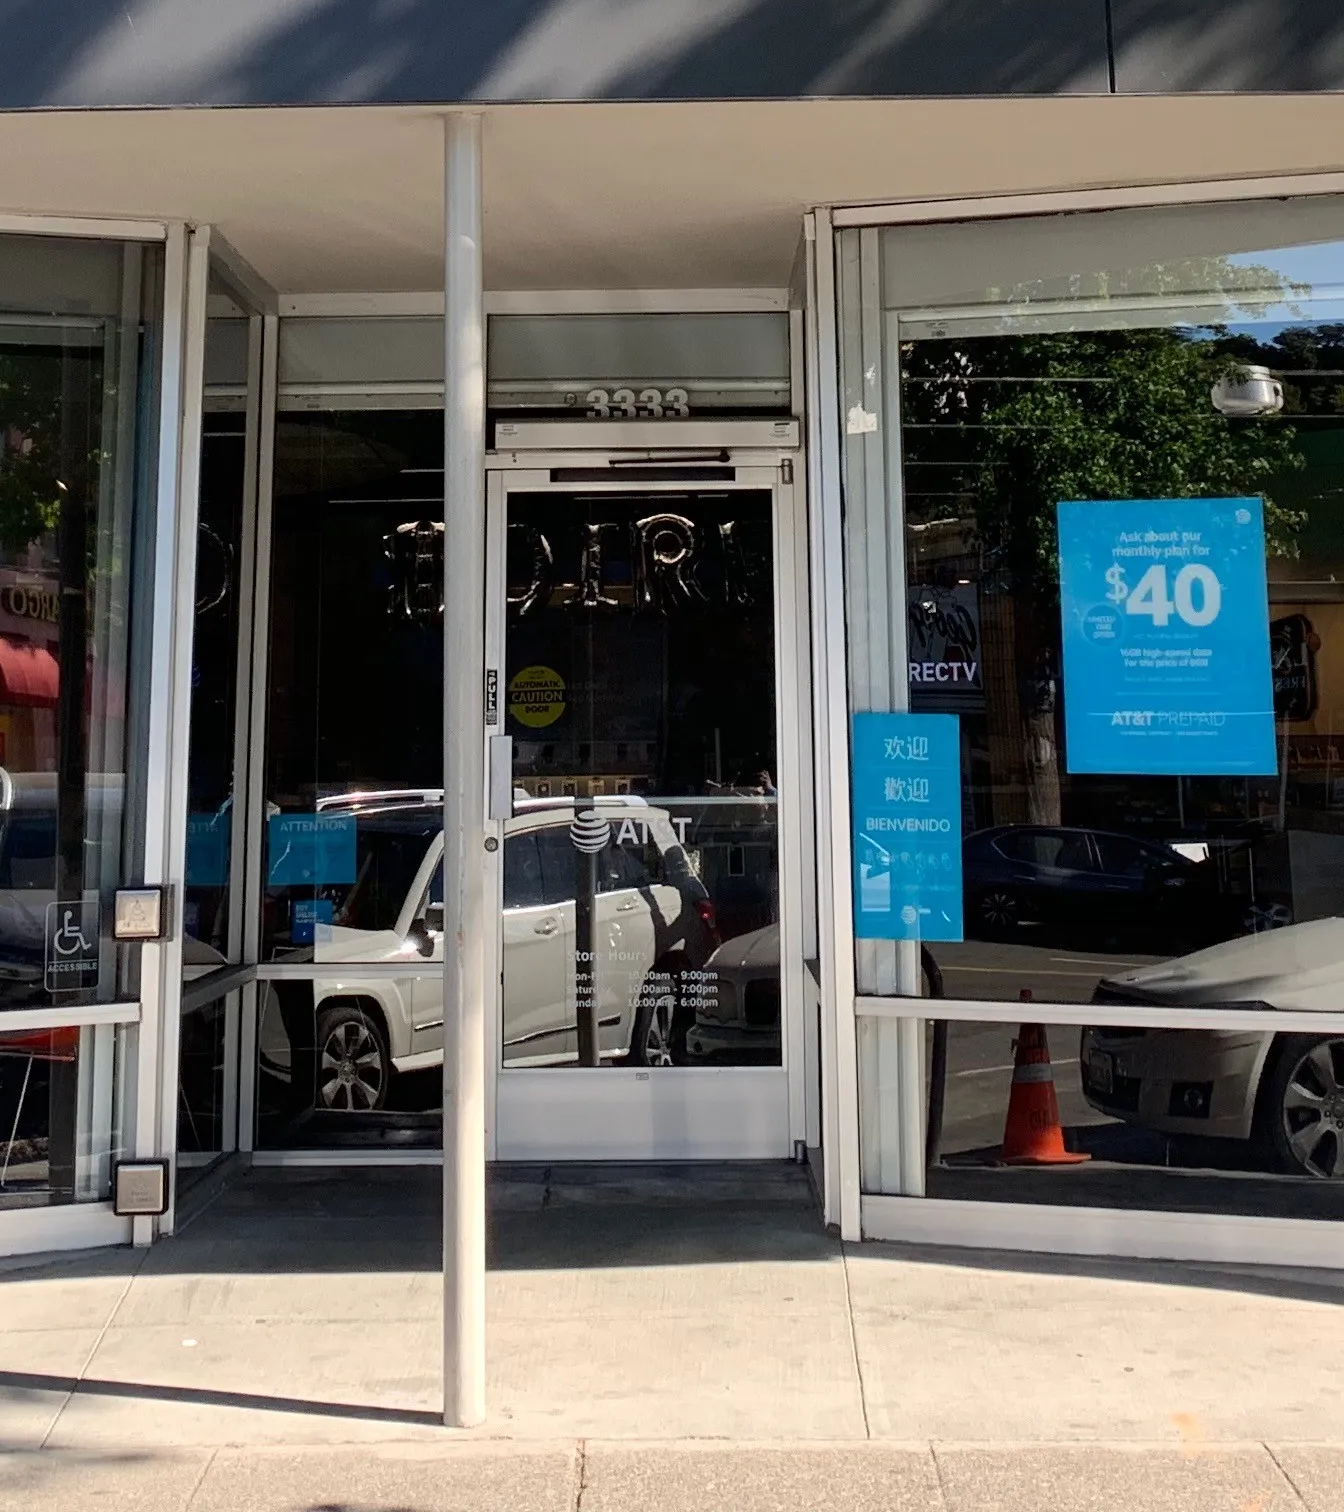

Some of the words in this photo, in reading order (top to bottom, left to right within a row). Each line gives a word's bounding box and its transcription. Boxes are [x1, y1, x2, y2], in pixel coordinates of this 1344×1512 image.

[586, 388, 689, 417] 3333
[1119, 531, 1142, 542] Ask
[1145, 531, 1177, 542] about
[1112, 546, 1161, 558] monthly
[1165, 546, 1190, 558] plan
[1193, 545, 1210, 556] for
[1105, 562, 1221, 626] $40
[908, 662, 977, 682] RECTV
[511, 691, 563, 703] CAUTION
[1111, 711, 1154, 726] AT&T
[1158, 711, 1226, 727] PREPAID
[884, 736, 929, 761] 欢迎
[884, 777, 930, 802] 歡迎
[280, 820, 347, 832] ATTENTION
[616, 817, 693, 844] ATT
[866, 818, 951, 832] BIENVENIDO
[608, 949, 647, 962] Hours
[47, 962, 98, 972] ACCESSIBLE
[681, 971, 718, 982] 9:00pm
[681, 984, 718, 995] 7:00pm
[680, 998, 718, 1009] 6:00pm
